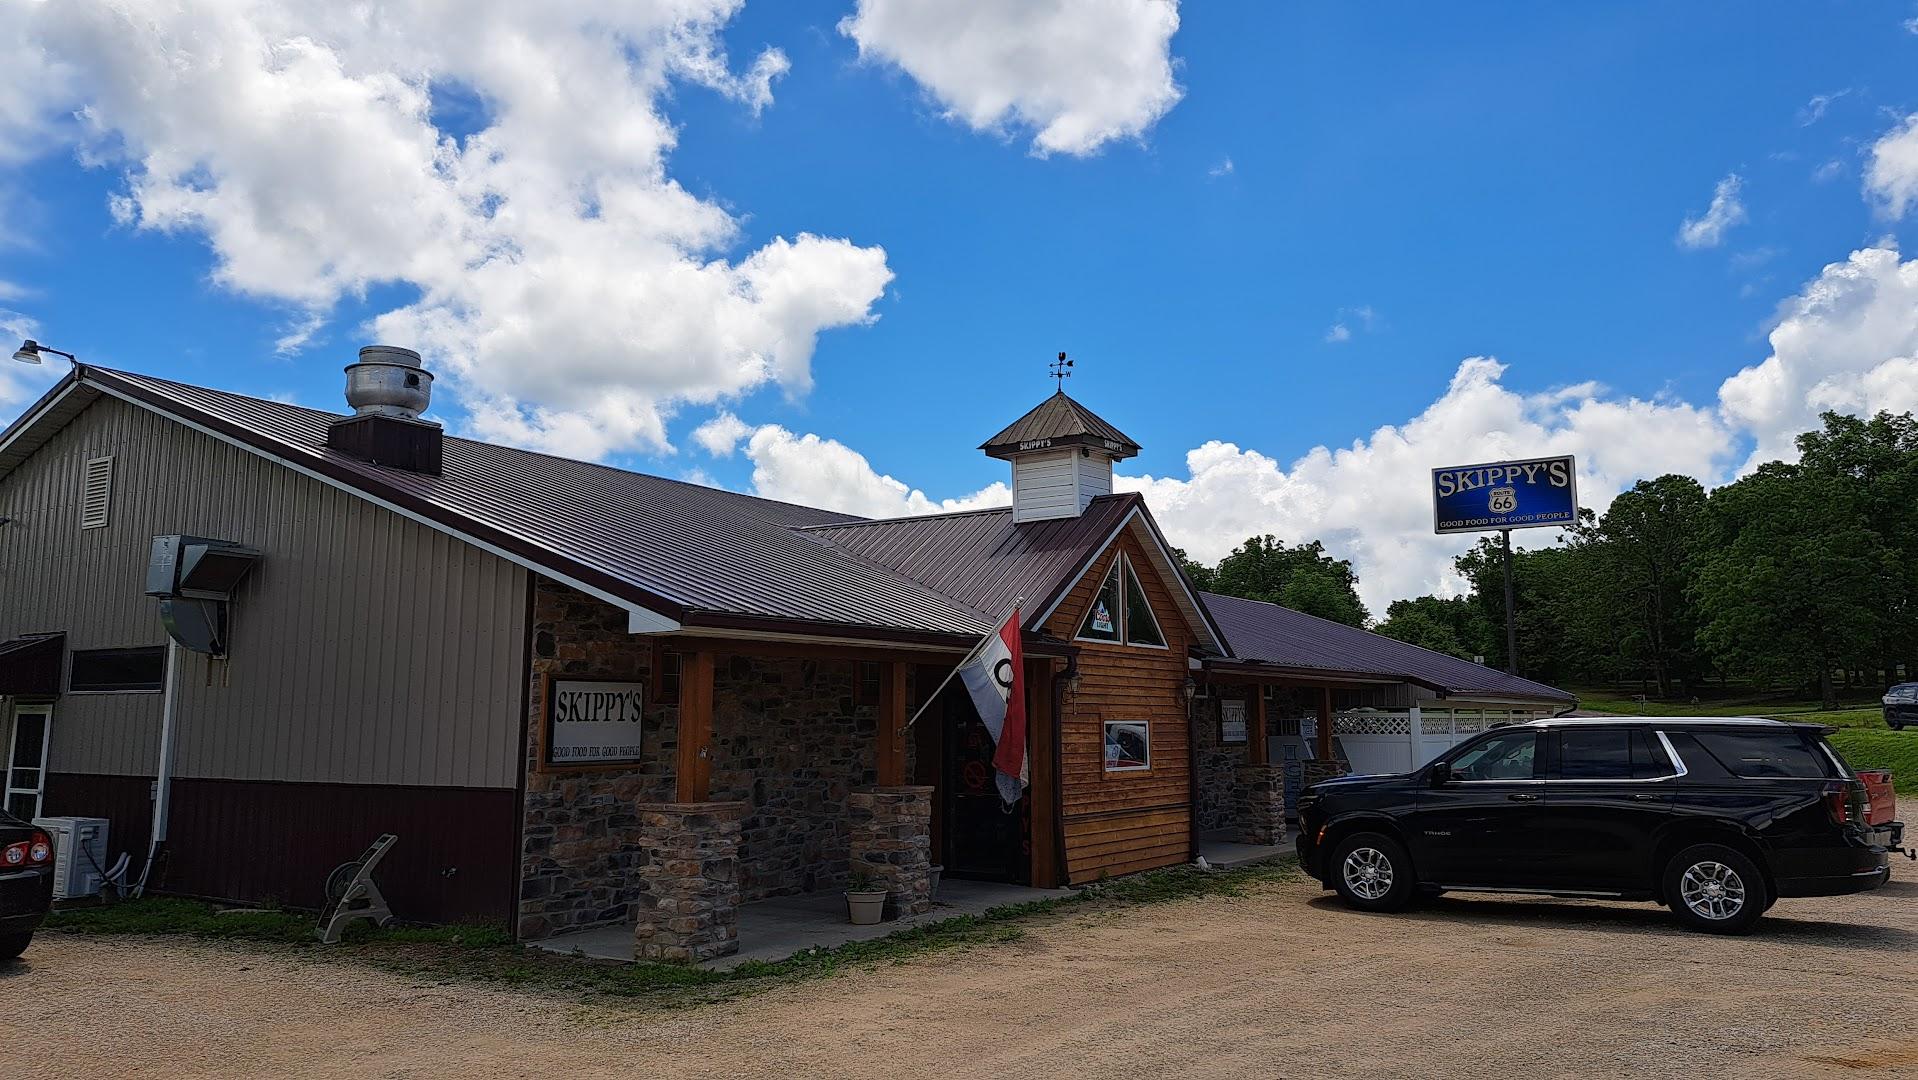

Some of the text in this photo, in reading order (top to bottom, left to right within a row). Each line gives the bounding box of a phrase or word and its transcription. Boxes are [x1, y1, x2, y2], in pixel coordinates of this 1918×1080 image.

[1019, 438, 1052, 451] SKIPPY'S
[1438, 461, 1569, 498] SKIPPY'S
[1493, 497, 1513, 510] 66
[1440, 520, 1464, 528] GOOD
[1465, 518, 1489, 526] FOOD
[1509, 515, 1534, 523] GOOD
[1536, 511, 1570, 520] PEOPLE
[556, 689, 641, 723] SKIPPY'S
[553, 746, 640, 758] GOOD FOOD FOR GOOD PEOPLE
